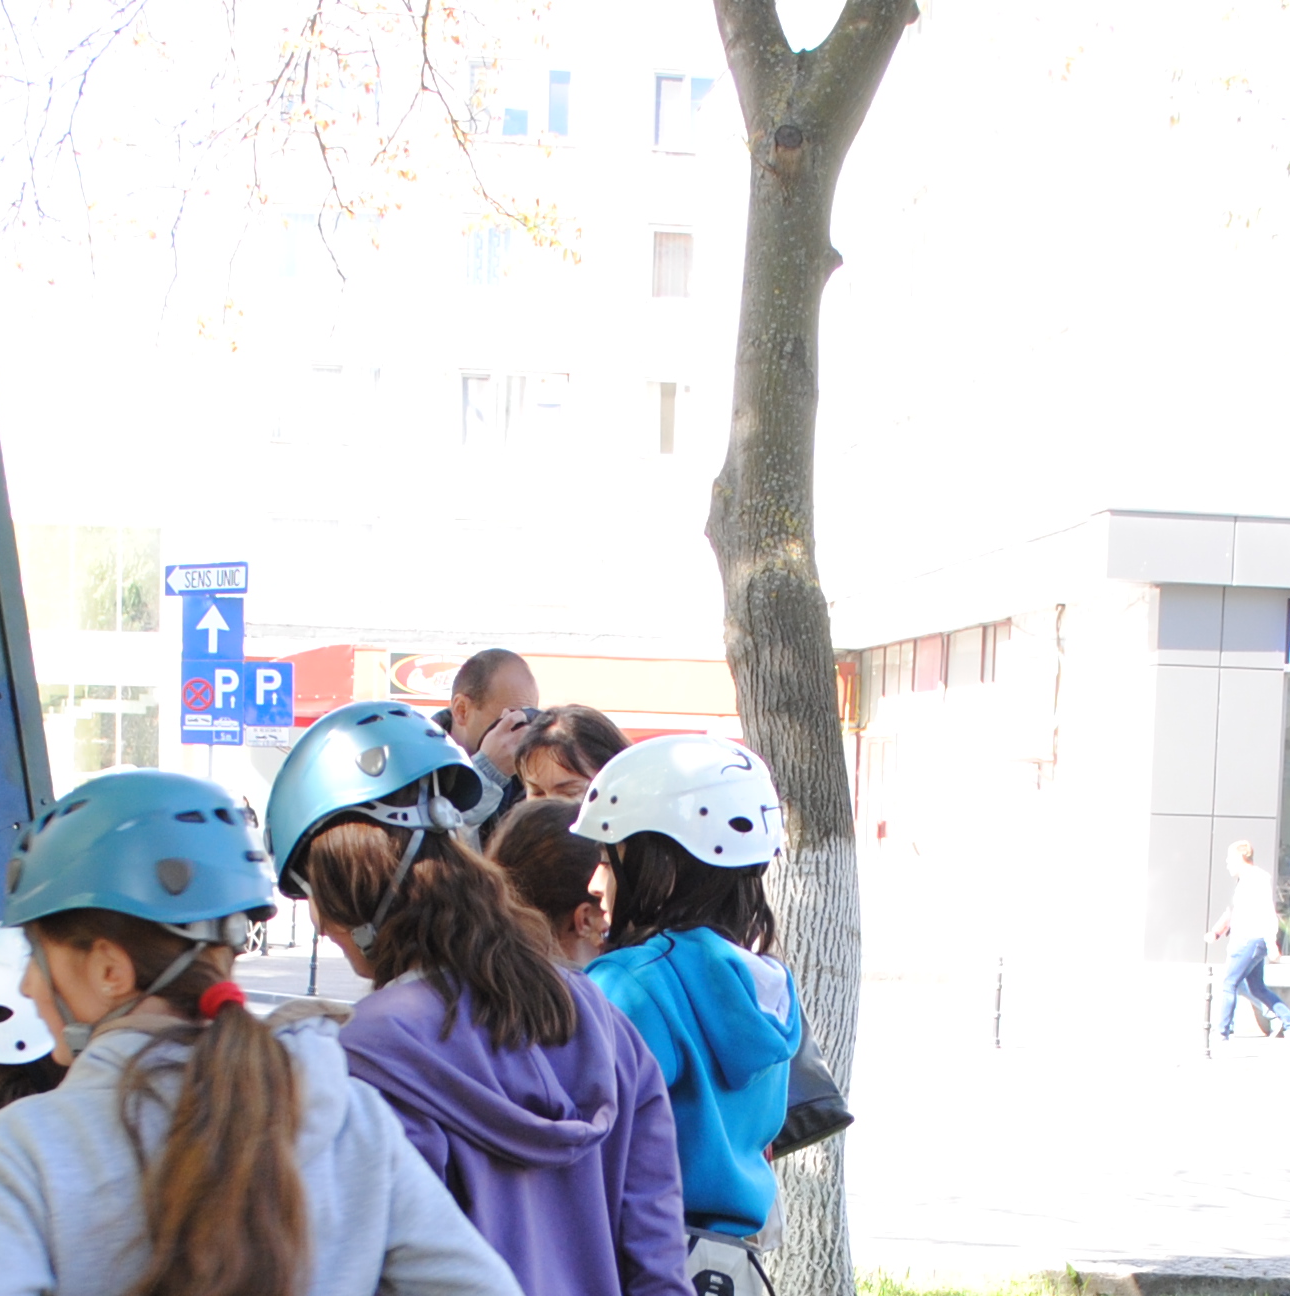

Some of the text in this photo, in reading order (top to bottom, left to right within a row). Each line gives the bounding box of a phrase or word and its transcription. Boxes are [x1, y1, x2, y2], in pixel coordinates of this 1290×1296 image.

[184, 568, 241, 589] SENS UNIC
[214, 668, 240, 709] P
[255, 668, 283, 705] P
